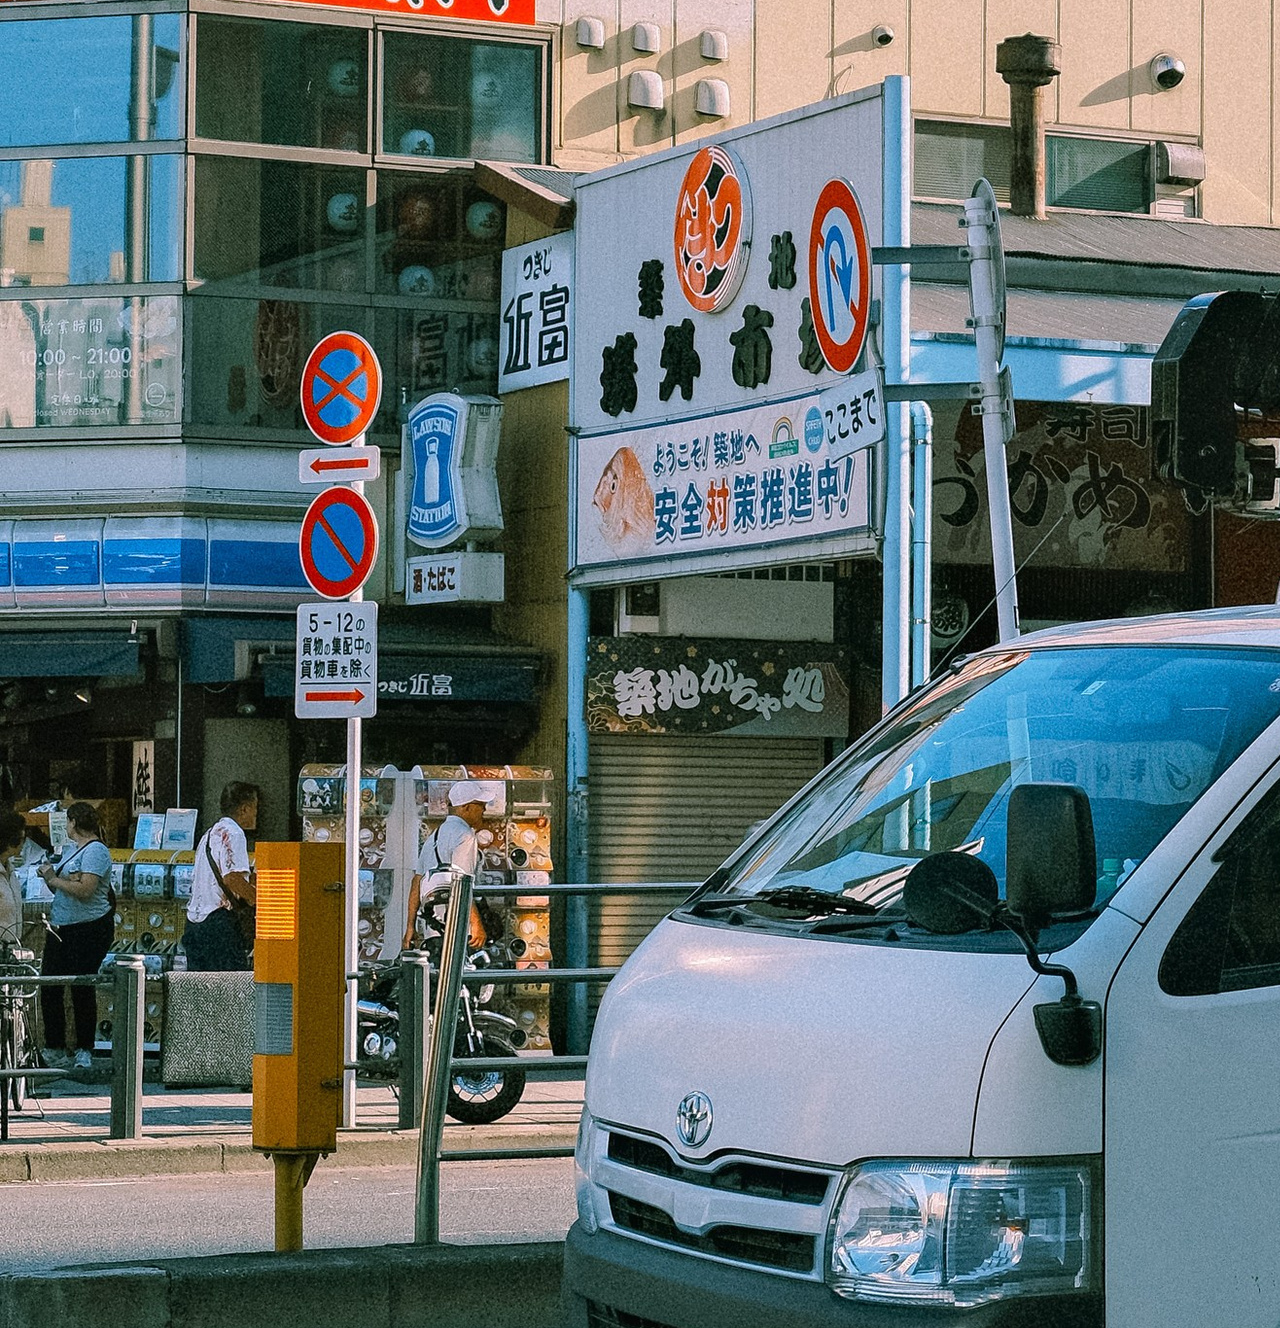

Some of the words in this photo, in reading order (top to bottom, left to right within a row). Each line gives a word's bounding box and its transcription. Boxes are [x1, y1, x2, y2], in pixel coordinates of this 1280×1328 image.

[523, 246, 553, 281] つきじ
[41, 318, 103, 336] 営業時間
[503, 283, 570, 376] 近富
[20, 348, 66, 365] 10:00
[87, 347, 131, 364] 21:00
[61, 407, 111, 417] WEDNESDAY
[825, 389, 876, 445] ここまで
[413, 416, 453, 440] LAWSON
[654, 455, 856, 545] 安全対策推進中!
[411, 501, 453, 524] STATION
[413, 566, 457, 595] 酒・たばこ
[302, 636, 372, 658] 貨物の集配中の
[301, 659, 371, 680] 貨物車を除く
[378, 676, 408, 694] つきじ
[410, 673, 454, 696] 近富
[613, 658, 825, 720] 築地がちゃ処
